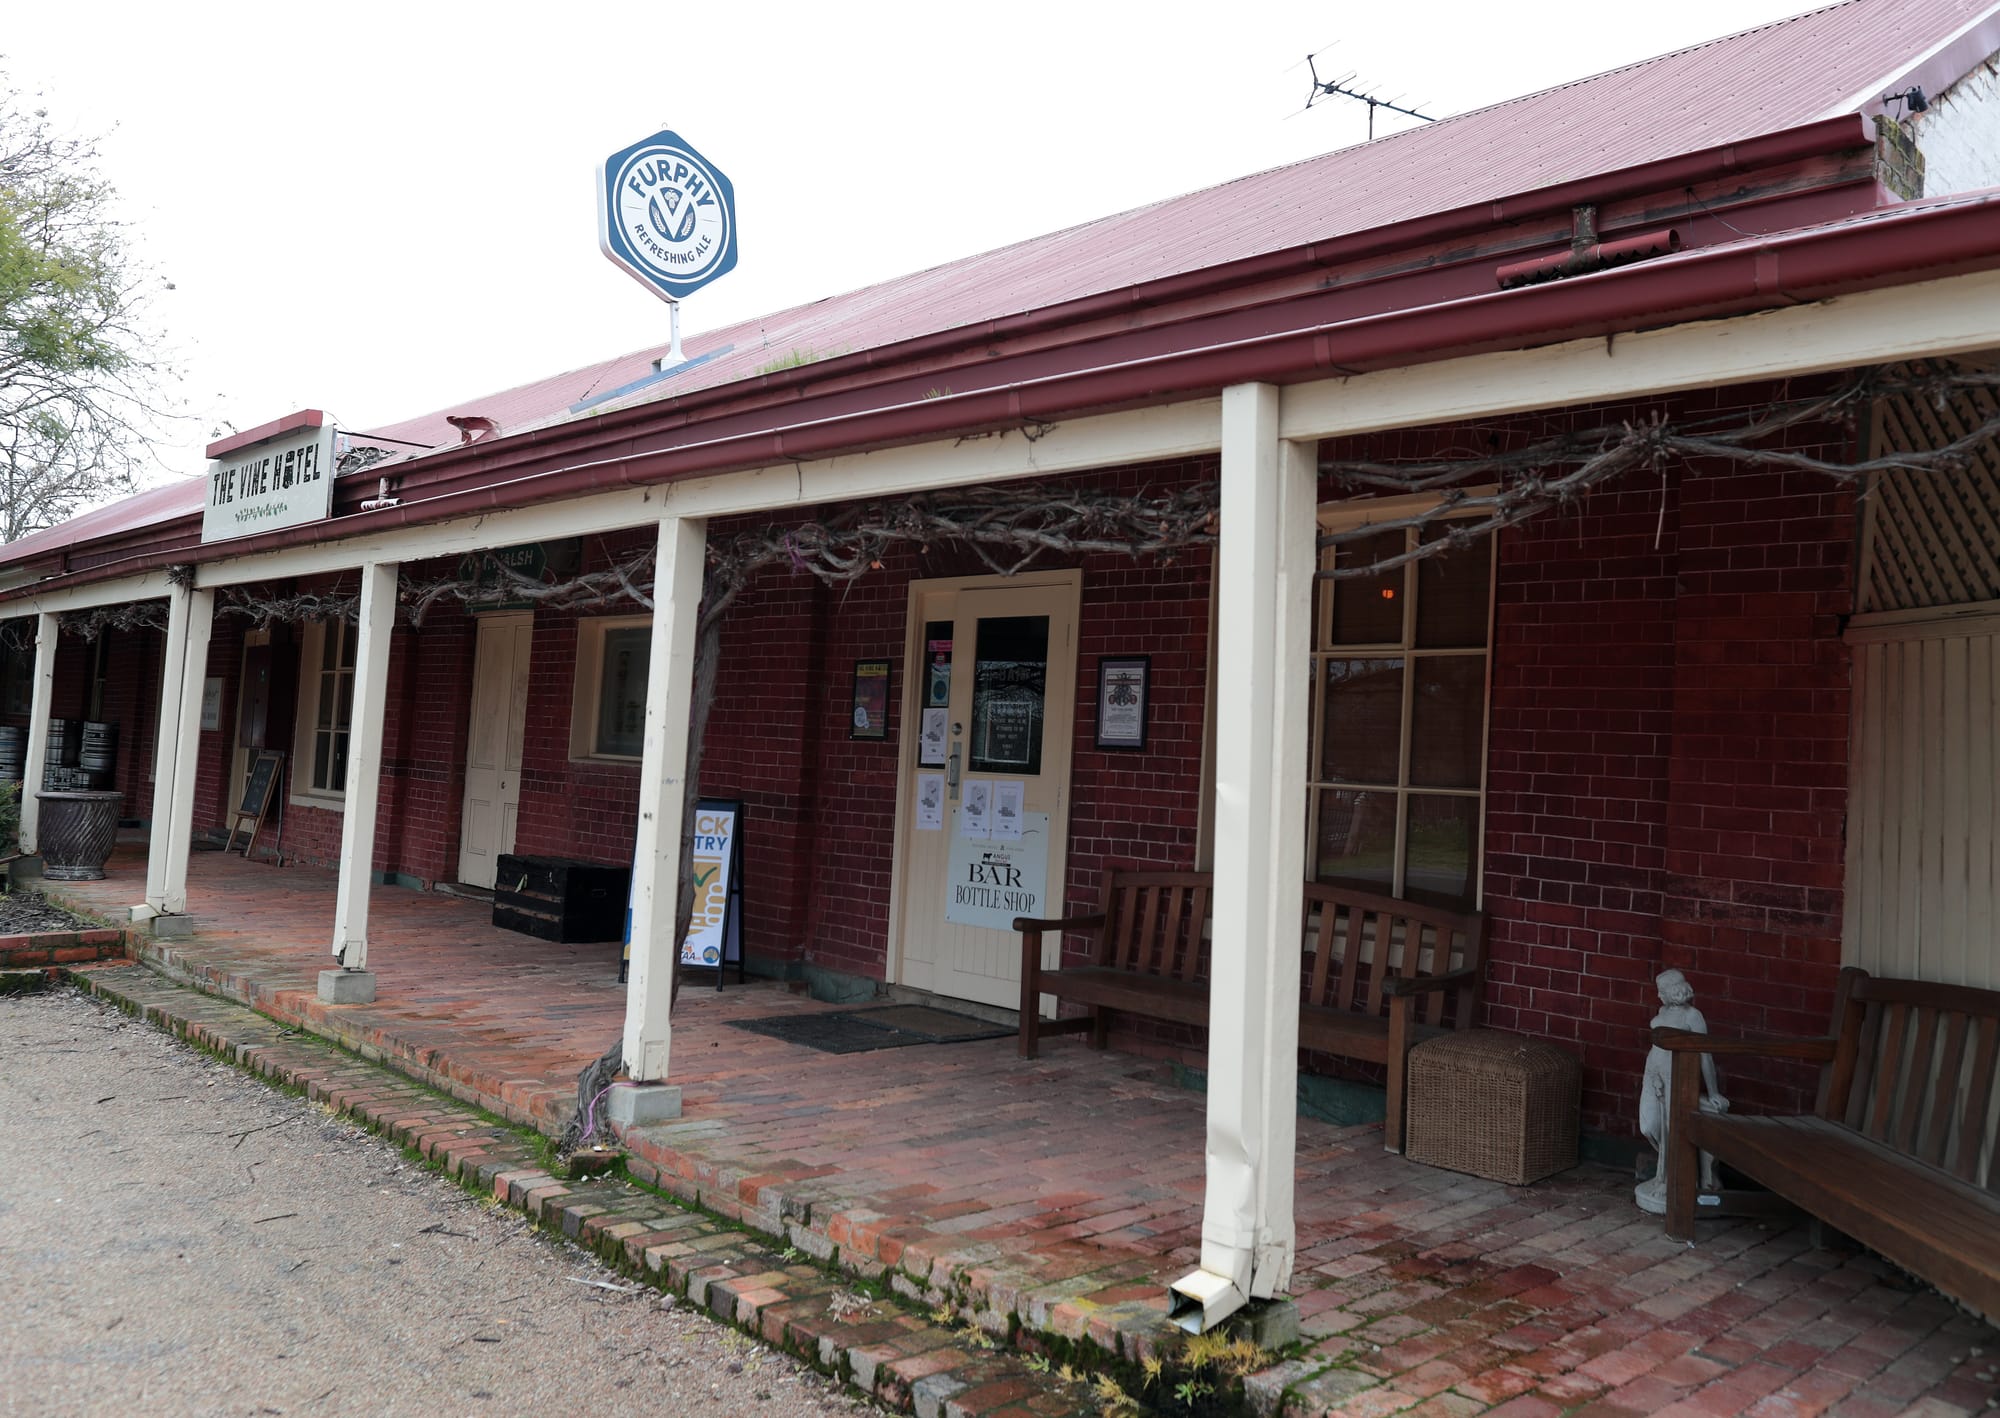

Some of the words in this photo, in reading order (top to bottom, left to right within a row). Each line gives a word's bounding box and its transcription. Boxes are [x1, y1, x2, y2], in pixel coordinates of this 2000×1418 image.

[628, 160, 715, 206] FURPHY
[634, 224, 695, 264] REFRESHING
[696, 234, 711, 258] ALE
[213, 469, 236, 506] THE
[240, 458, 269, 499] VINE
[697, 815, 730, 836] CK
[695, 836, 728, 850] TRY
[968, 863, 1023, 888] BAR
[955, 885, 1001, 910] BOTTLE
[1003, 890, 1036, 913] SHOP
